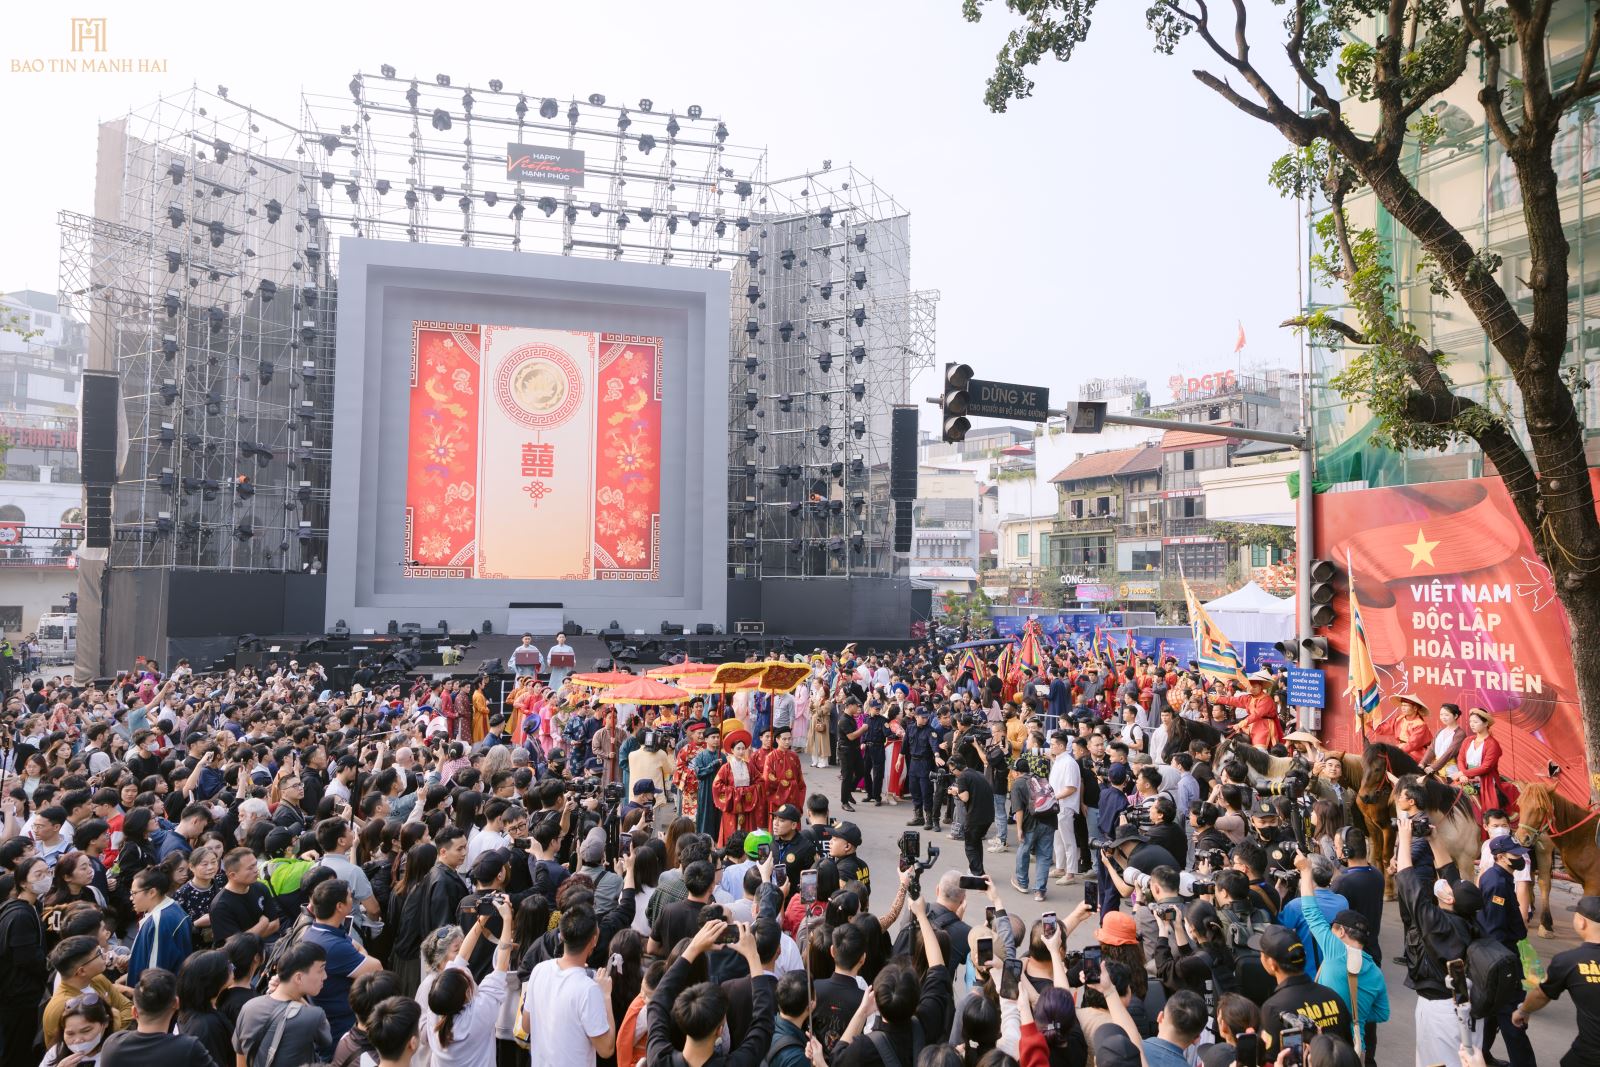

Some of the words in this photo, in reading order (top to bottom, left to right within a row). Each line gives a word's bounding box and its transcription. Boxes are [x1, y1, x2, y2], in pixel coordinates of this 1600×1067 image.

[533, 153, 561, 161] HAPPY
[981, 384, 1018, 404] DỪNG
[1021, 391, 1037, 407] XE
[1411, 579, 1456, 607] VIỆT
[1462, 584, 1511, 603] NAM
[1412, 607, 1454, 634] ĐỘC
[1459, 607, 1501, 637] LẬP
[1413, 635, 1456, 659] HOÀ
[1461, 635, 1515, 662] BÌNH
[1413, 662, 1466, 687] PHÁT
[1472, 665, 1542, 694] TRIỂN
[1322, 999, 1340, 1017] AN
